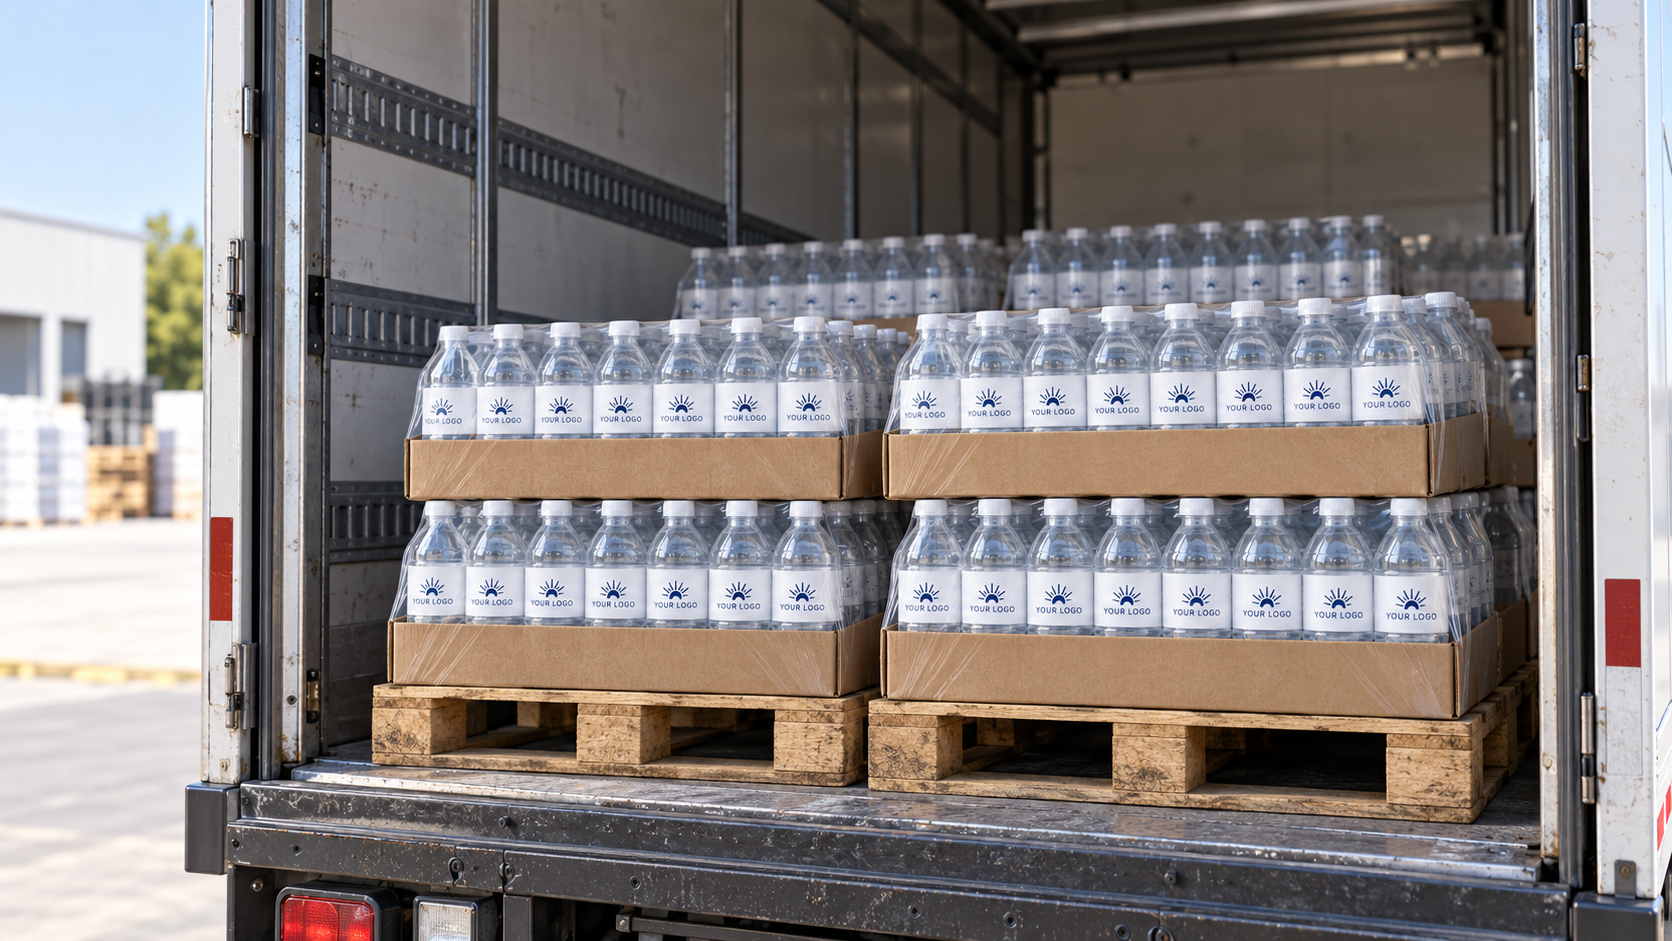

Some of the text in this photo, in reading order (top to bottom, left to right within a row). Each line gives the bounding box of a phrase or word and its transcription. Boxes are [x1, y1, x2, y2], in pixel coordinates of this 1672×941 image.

[1226, 404, 1272, 412] YOUR LOGO
[1294, 402, 1340, 410] YOUR LOGO
[1363, 400, 1411, 409] YOUR LOGO
[1031, 408, 1075, 416] YOUR LOGO
[1095, 407, 1139, 415] YOUR LOGO
[1159, 405, 1204, 413] YOUR LOGO
[600, 415, 641, 423] YOUR LOGO
[723, 414, 766, 422] YOUR LOGO
[924, 411, 946, 419] LOGO
[541, 416, 582, 424] YOUR LOGO
[592, 600, 635, 608] YOUR LOGO
[654, 601, 697, 609] YOUR LOGO
[717, 602, 761, 610] YOUR LOGO
[780, 603, 825, 611] YOUR LOGO
[905, 604, 949, 612] YOUR LOGO
[970, 605, 1015, 613] YOUR LOGO
[1036, 606, 1082, 615] YOUR LOGO
[1104, 607, 1151, 615] YOUR LOGO
[1173, 608, 1220, 617] YOUR LOGO
[1243, 610, 1291, 618] YOUR LOGO
[1315, 611, 1363, 620] YOUR LOGO
[1386, 612, 1437, 621] YOUR LOGO
